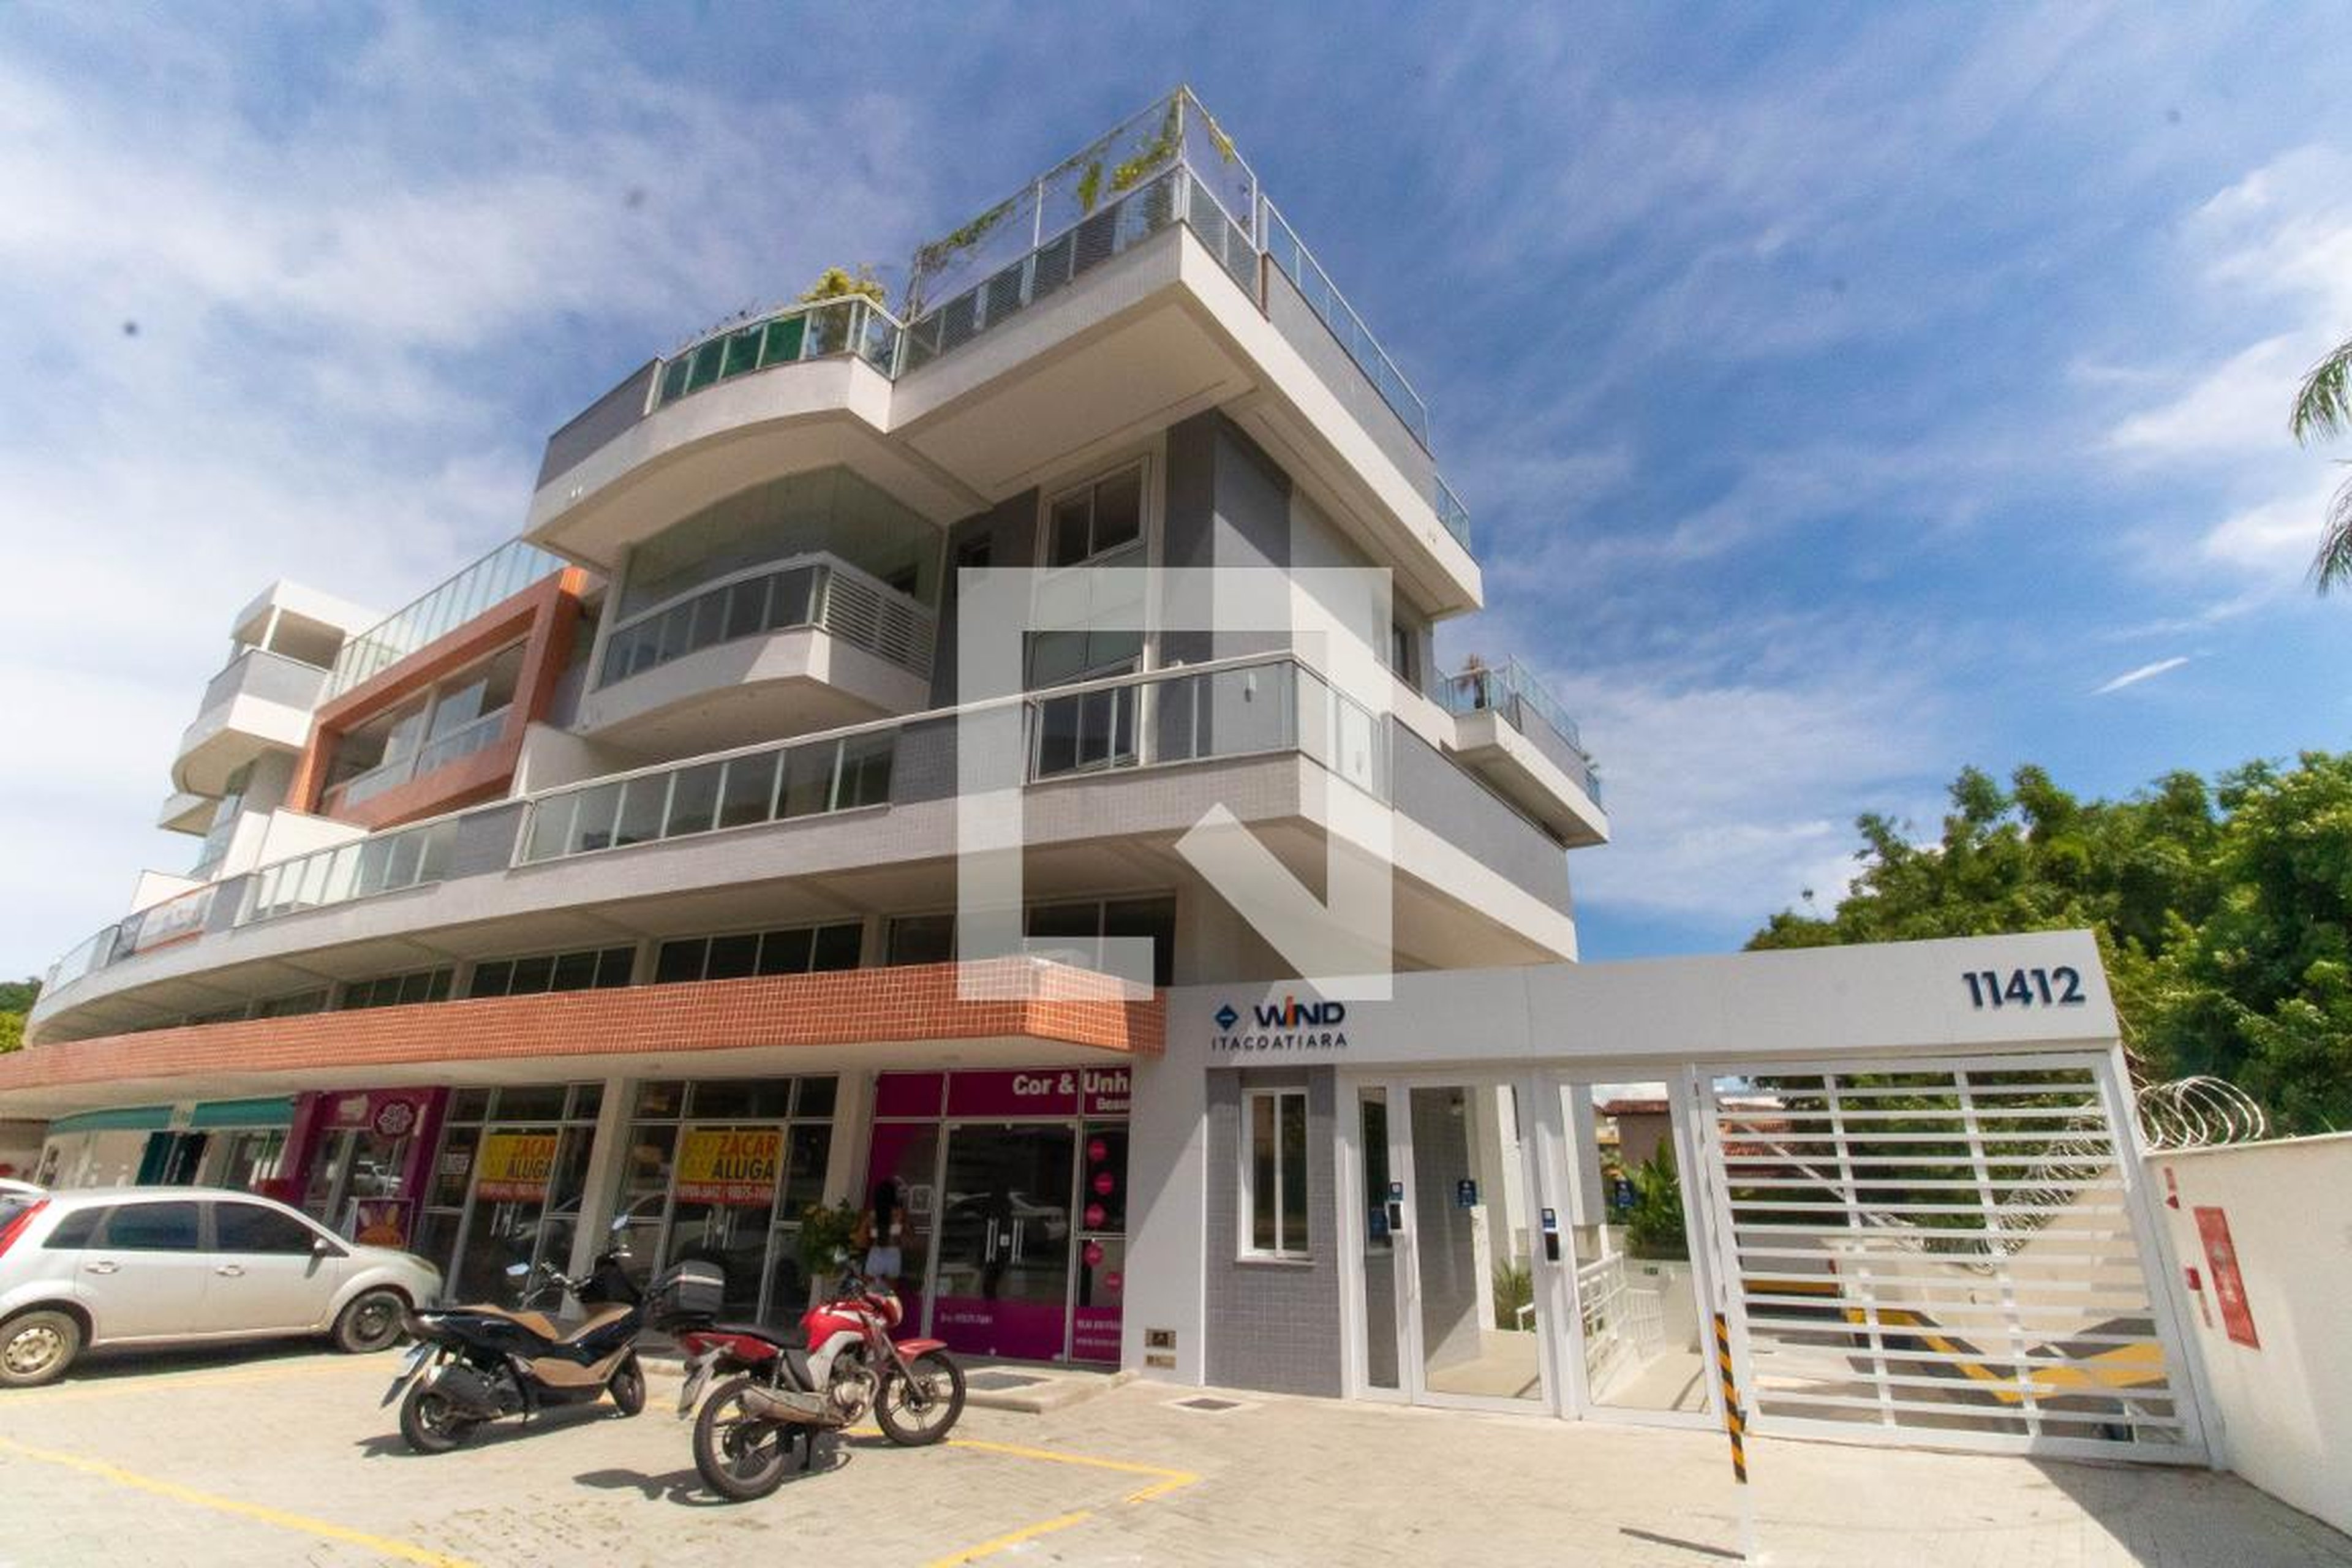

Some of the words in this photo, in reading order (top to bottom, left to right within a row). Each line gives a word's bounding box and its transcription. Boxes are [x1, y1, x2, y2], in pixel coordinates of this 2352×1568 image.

[1963, 966, 2085, 1006] 11412
[1254, 995, 1346, 1030] WIND
[1212, 1033, 1348, 1051] ITACOATIARA
[1012, 1074, 1052, 1095] Cor
[1058, 1072, 1075, 1094] &
[1085, 1072, 1131, 1093] Unh
[711, 1158, 775, 1179] ALUGA
